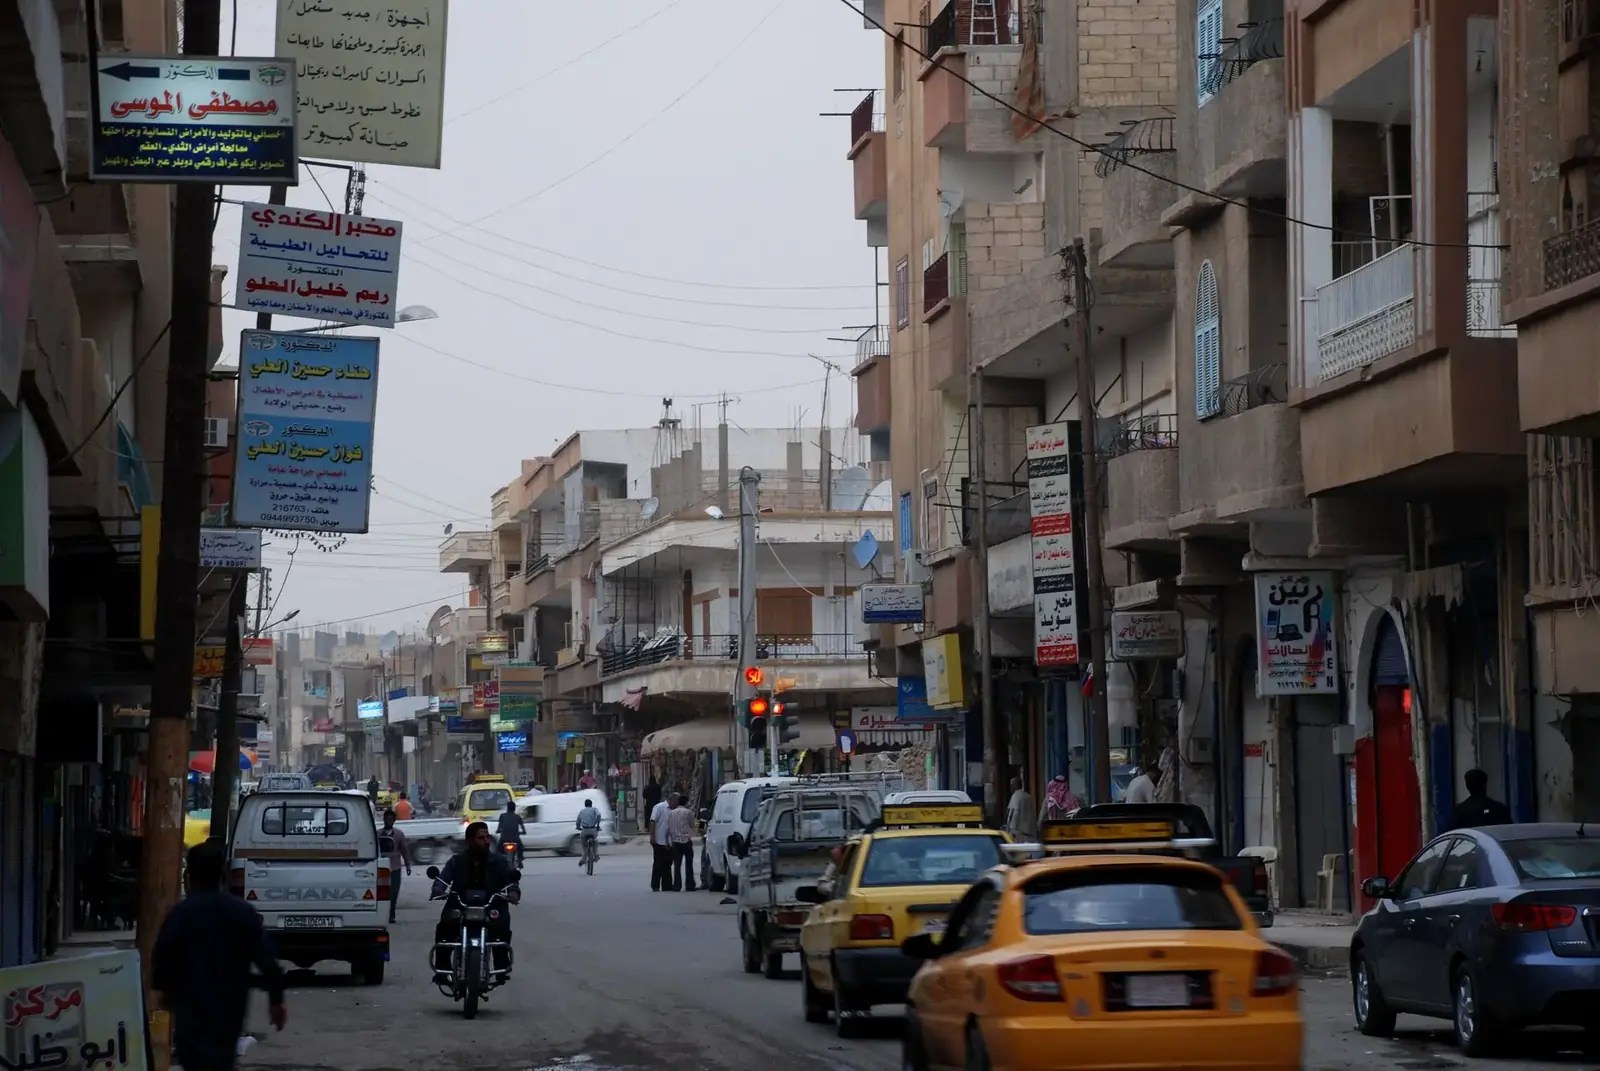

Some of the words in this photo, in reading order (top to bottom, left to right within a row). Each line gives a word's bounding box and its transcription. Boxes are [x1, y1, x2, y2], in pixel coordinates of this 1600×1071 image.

[164, 64, 218, 80] الدكتور
[111, 89, 183, 120] الموسى
[188, 90, 279, 120] مصطفى
[359, 127, 409, 151] صيانة
[251, 208, 342, 237] الكندي
[345, 217, 397, 238] مخبر
[250, 233, 312, 252] الطبية
[316, 244, 390, 262] للتحاليل
[287, 263, 343, 277] الدكتورة
[245, 277, 296, 294] العلو
[297, 280, 348, 298] خليل
[356, 288, 390, 305] ريم
[280, 337, 338, 352] الدكتورة
[247, 357, 290, 379] العلي
[290, 360, 334, 379] حسين
[335, 363, 372, 380] هناء
[281, 422, 334, 439] الدكتور
[247, 440, 287, 460] العلي
[288, 443, 330, 463] حسين
[331, 444, 364, 464] فواز
[264, 888, 358, 900] CHANA
[4, 985, 83, 1027] مركز
[80, 1021, 126, 1069] أبو
